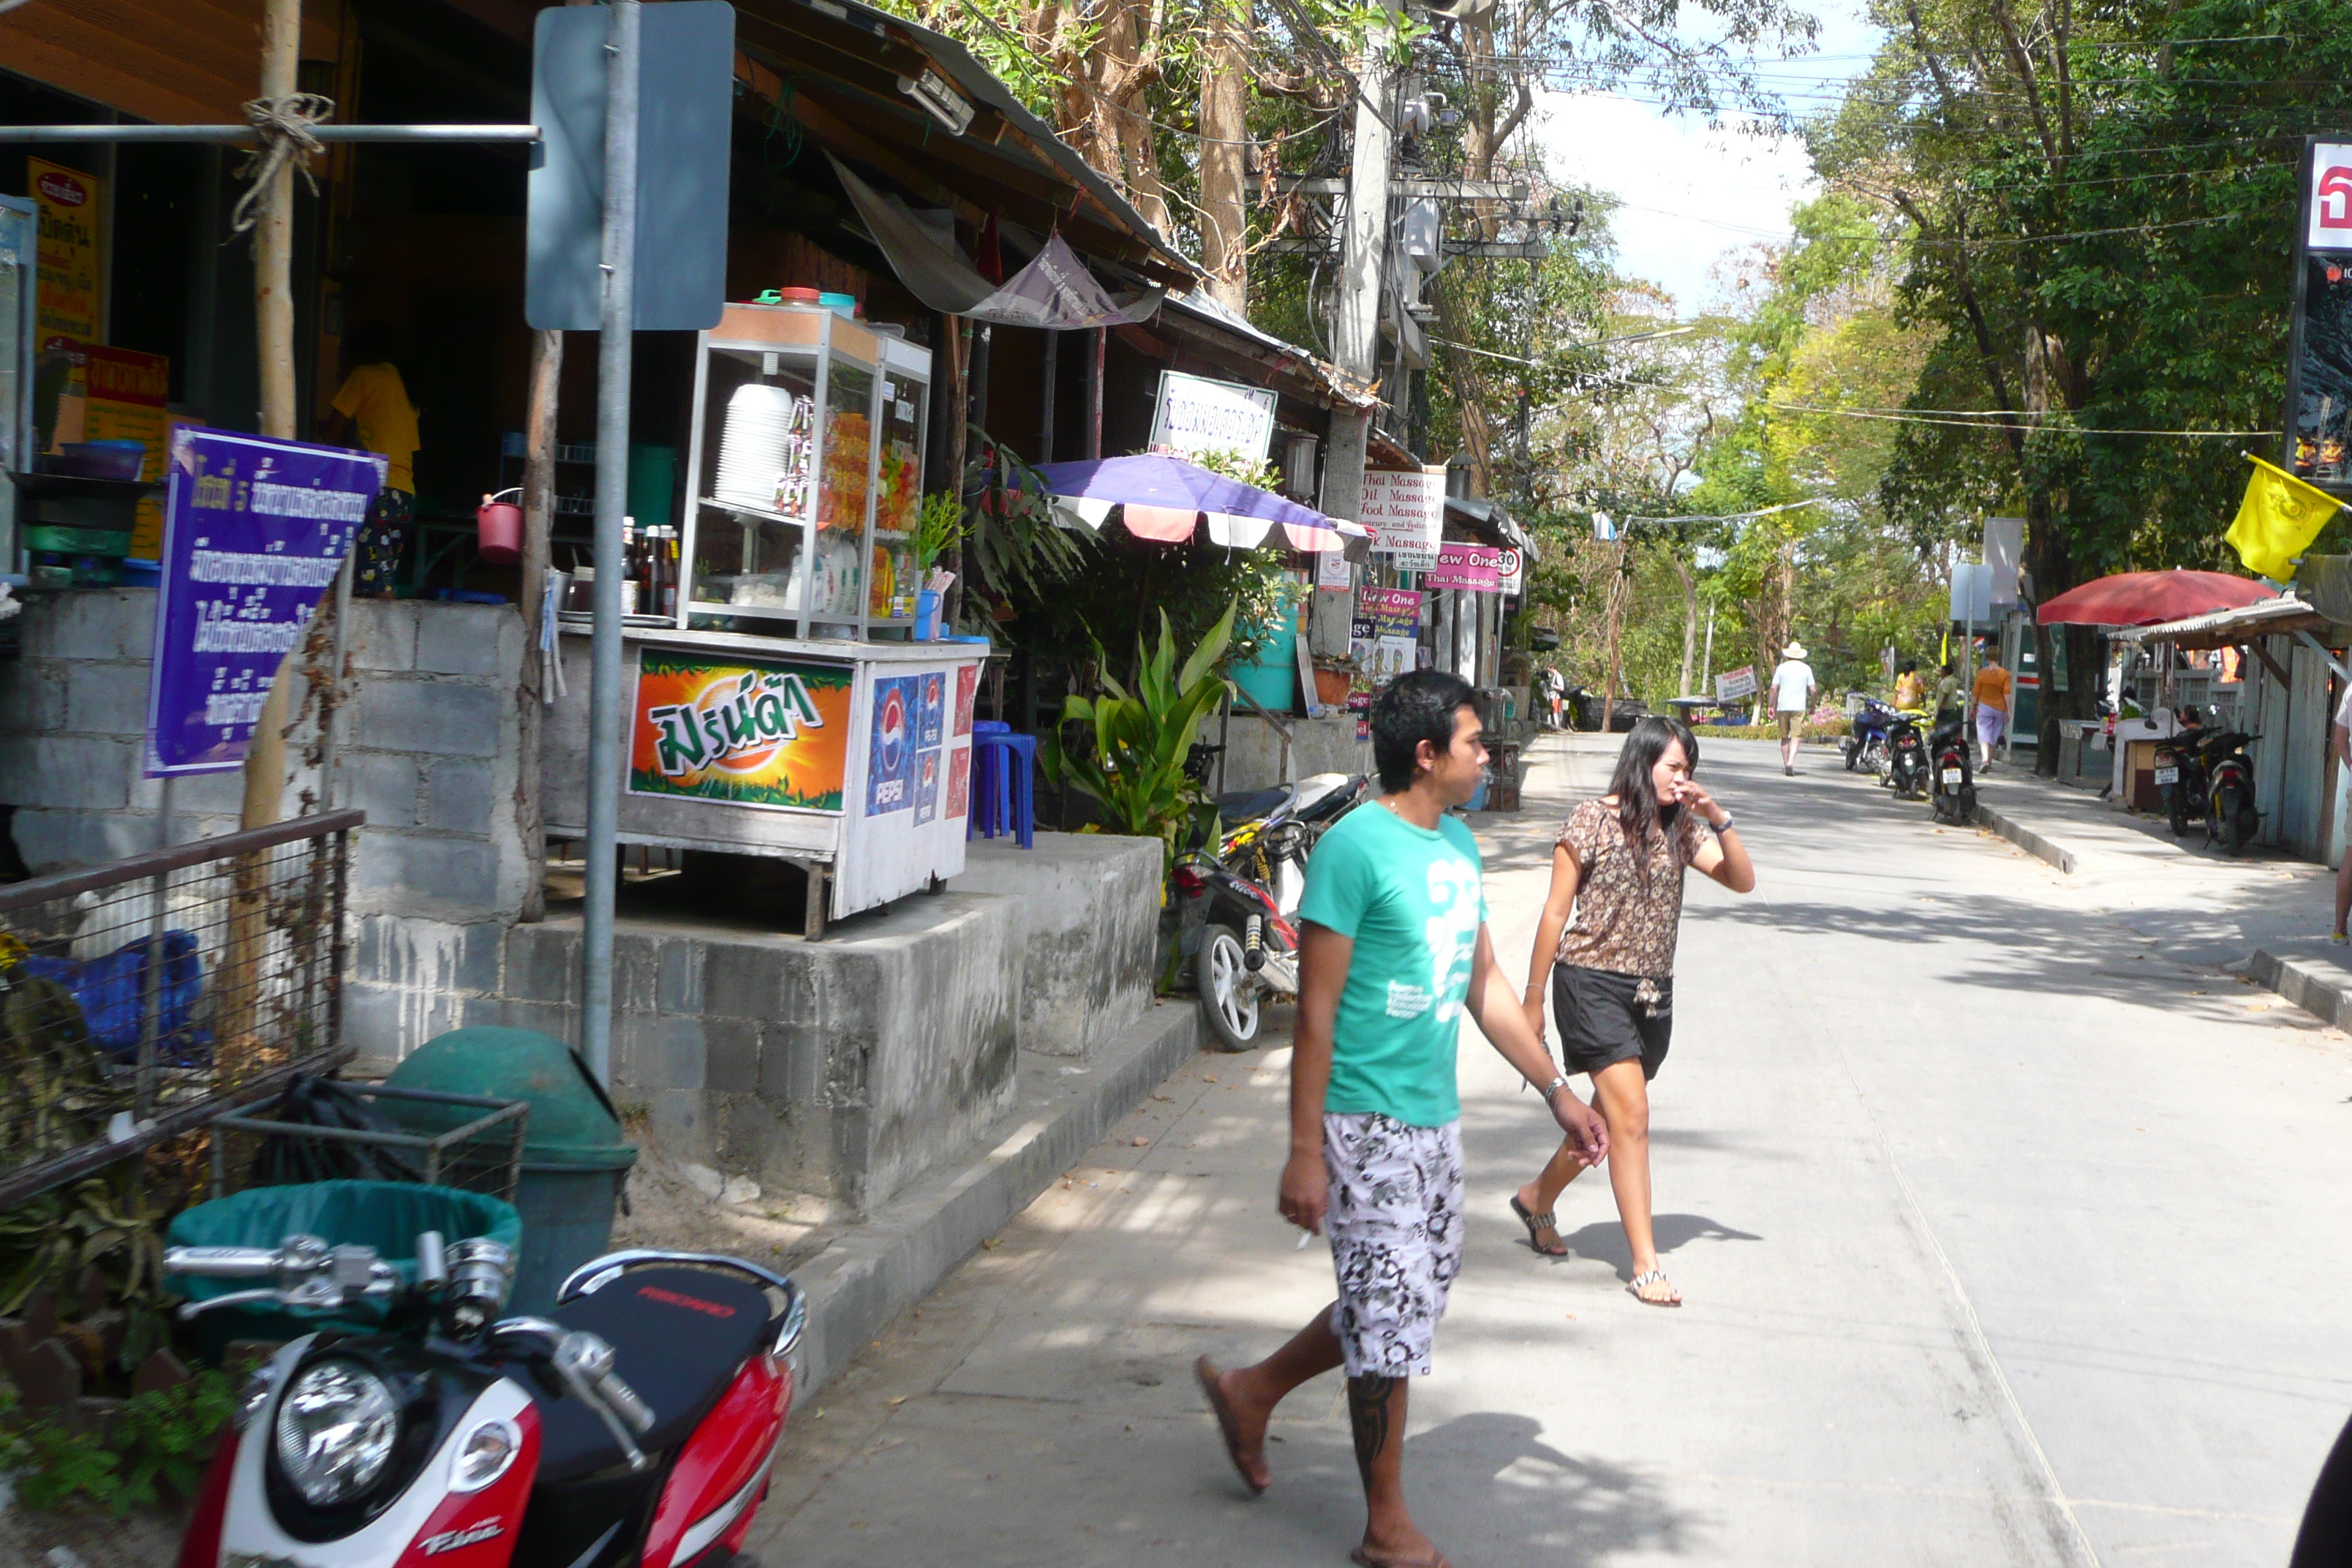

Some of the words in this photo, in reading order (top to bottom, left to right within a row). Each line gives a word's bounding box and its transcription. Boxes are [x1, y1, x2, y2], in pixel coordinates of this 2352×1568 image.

[1363, 473, 1385, 486] Thai
[1389, 489, 1438, 504] Massage
[1388, 504, 1438, 521] Massage
[1360, 519, 1387, 527] anicure
[1392, 520, 1405, 528] and
[1385, 535, 1436, 552] Massage
[1439, 554, 1464, 565] ew
[1469, 552, 1499, 568] One
[1498, 553, 1515, 565] 30
[1426, 573, 1449, 584] Thai
[1452, 575, 1496, 587] Massage
[1392, 593, 1415, 605] One
[1379, 614, 1414, 626] Maage
[876, 779, 904, 805] PEPSI
